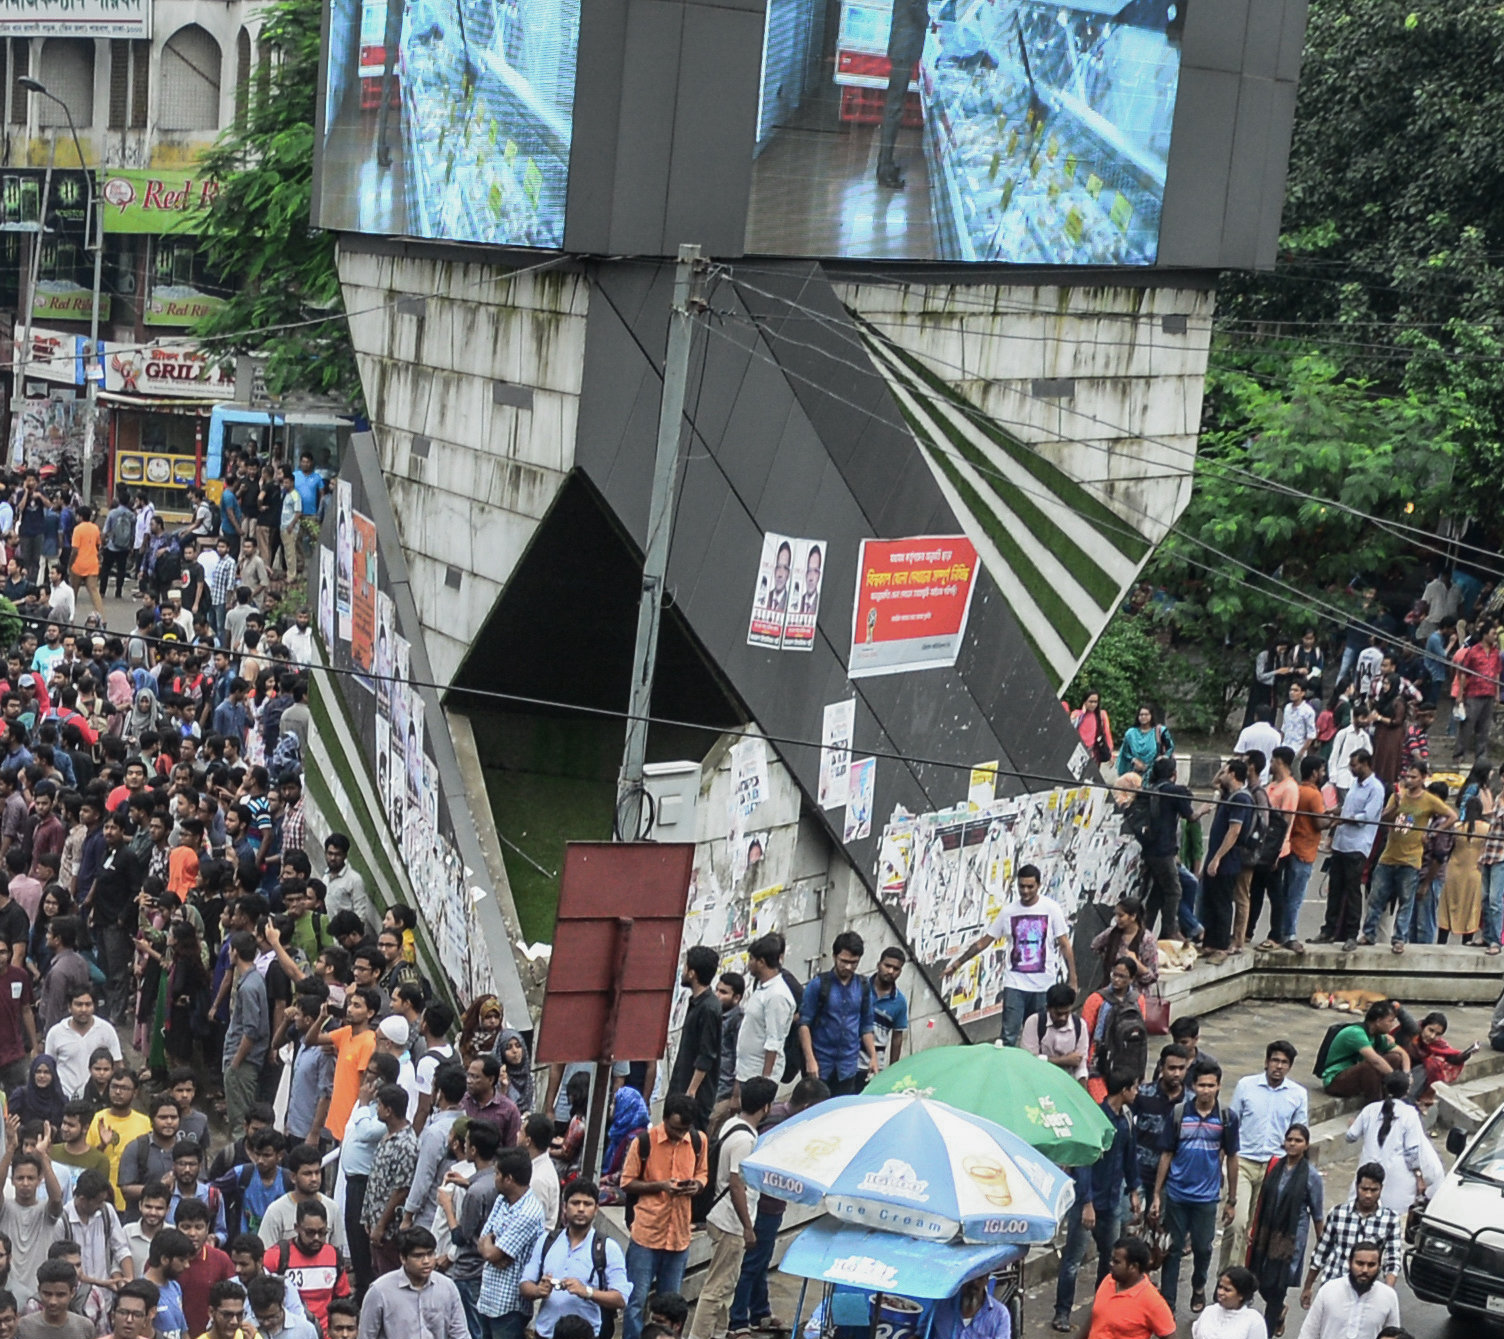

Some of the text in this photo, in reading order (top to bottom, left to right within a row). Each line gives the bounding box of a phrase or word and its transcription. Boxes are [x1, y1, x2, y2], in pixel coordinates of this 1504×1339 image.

[143, 179, 191, 211] Red
[145, 362, 212, 381] GRILL
[763, 1171, 804, 1194] IGLOO
[836, 1200, 943, 1233] Ice Cream
[983, 1219, 1029, 1234] IGLOO
